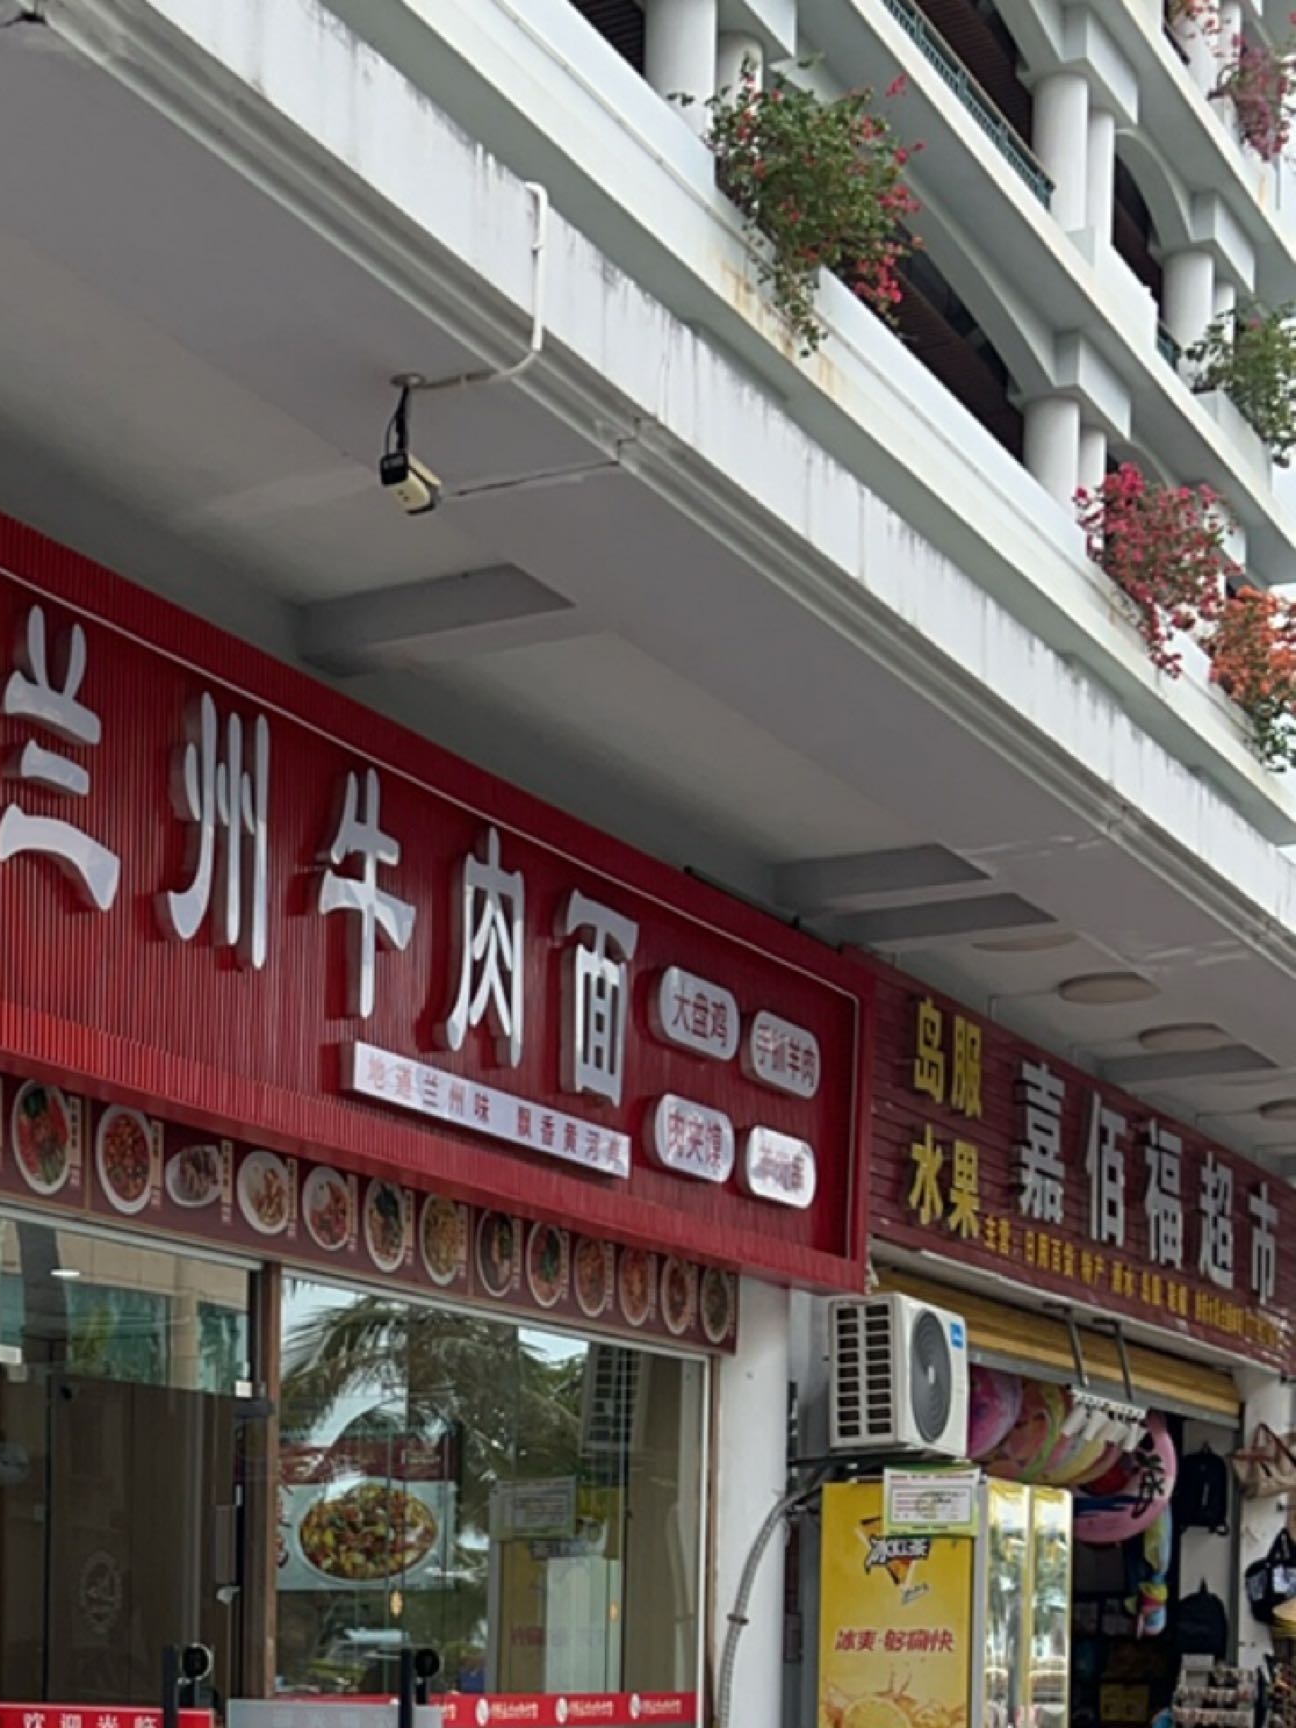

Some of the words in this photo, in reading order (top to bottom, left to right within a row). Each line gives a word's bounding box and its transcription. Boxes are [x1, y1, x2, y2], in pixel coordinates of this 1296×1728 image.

[671, 984, 728, 1048] 大盘鸡
[912, 996, 984, 1119] 岛服
[366, 1054, 491, 1124] 地道兰州味
[908, 1122, 981, 1241] 水果
[1017, 1060, 1280, 1306] 嘉佰福超市
